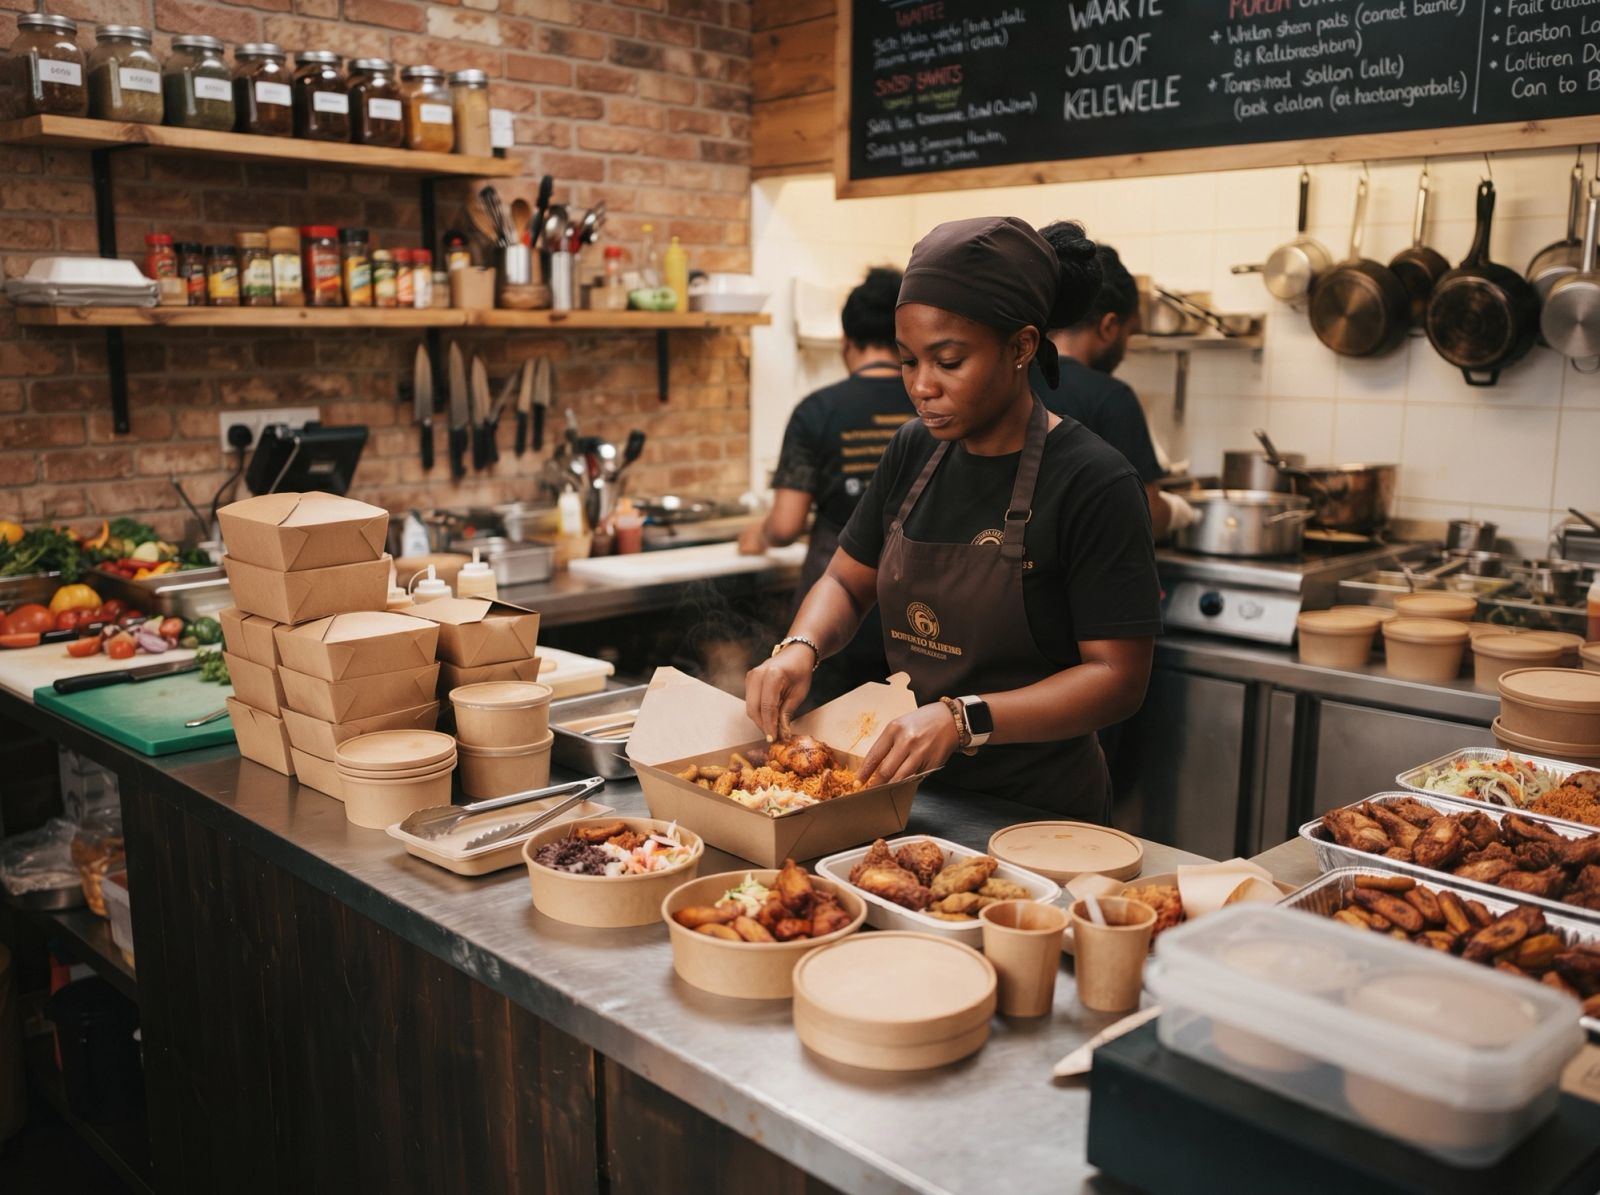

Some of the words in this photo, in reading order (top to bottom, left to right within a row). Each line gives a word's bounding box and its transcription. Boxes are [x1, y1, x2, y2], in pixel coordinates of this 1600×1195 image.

[1065, 32, 1152, 77] JOLLOF
[1063, 74, 1182, 121] KELEWELE
[1511, 76, 1548, 99] Can
[1558, 74, 1578, 94] to
